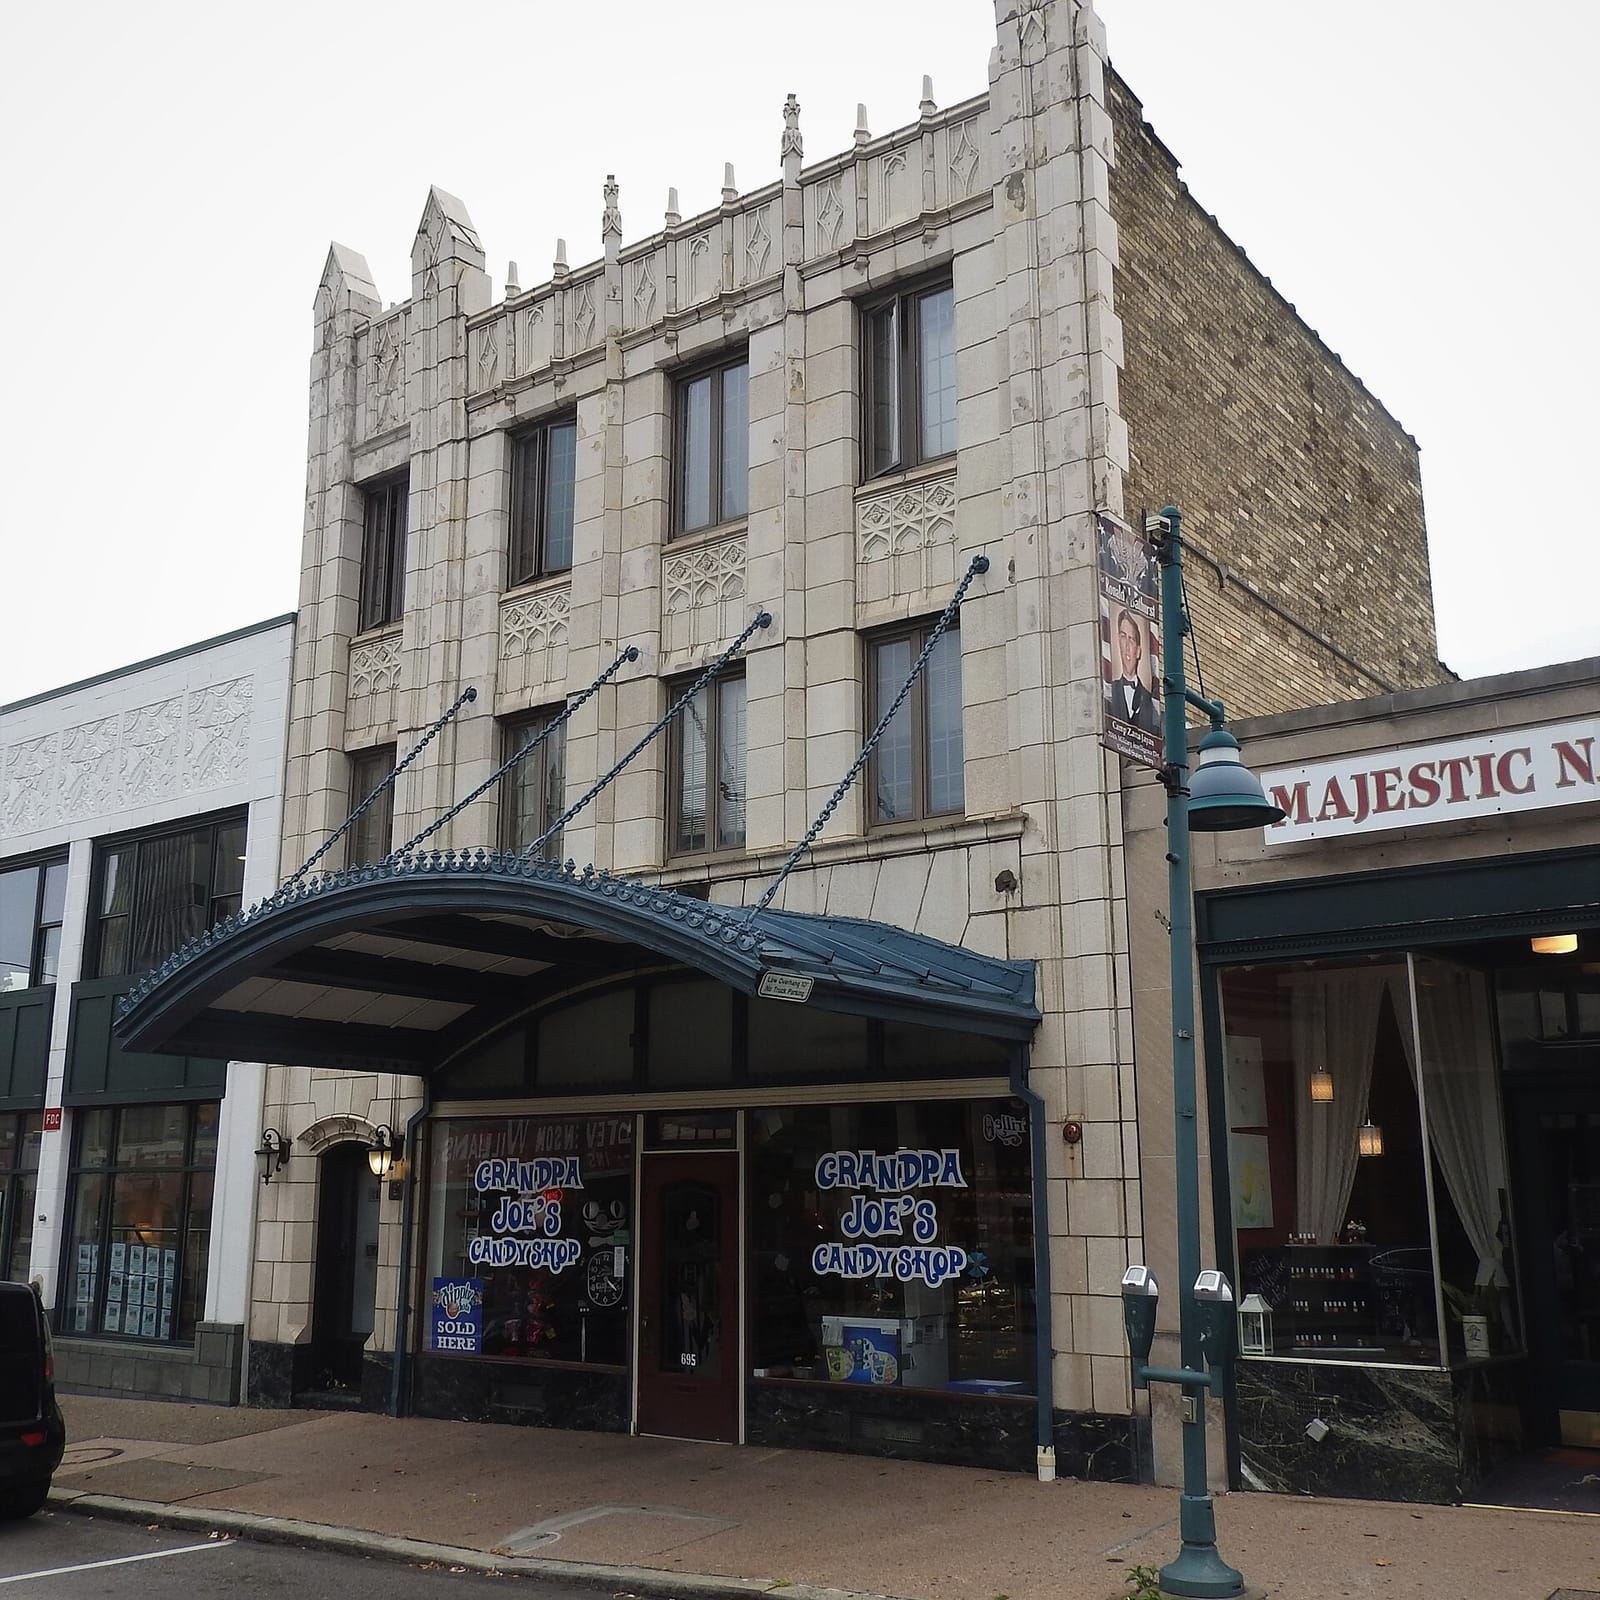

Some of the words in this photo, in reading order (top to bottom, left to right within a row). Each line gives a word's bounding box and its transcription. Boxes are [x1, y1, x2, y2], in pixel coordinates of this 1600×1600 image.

[1268, 747, 1536, 828] MAJESTIC
[1551, 737, 1600, 788] N
[46, 1114, 60, 1125] FDC
[475, 1157, 584, 1193] GRANDPA
[815, 1149, 968, 1192] GRANDPA
[492, 1196, 562, 1236] JOE'S
[841, 1195, 937, 1243] JOE'S
[469, 1236, 530, 1266] CANDY
[528, 1238, 581, 1274] SHOP
[812, 1242, 895, 1278] CANDY
[896, 1245, 968, 1288] SHOP
[437, 1321, 475, 1335] SOLD
[437, 1336, 476, 1351] HERE
[680, 1352, 697, 1367] 695
